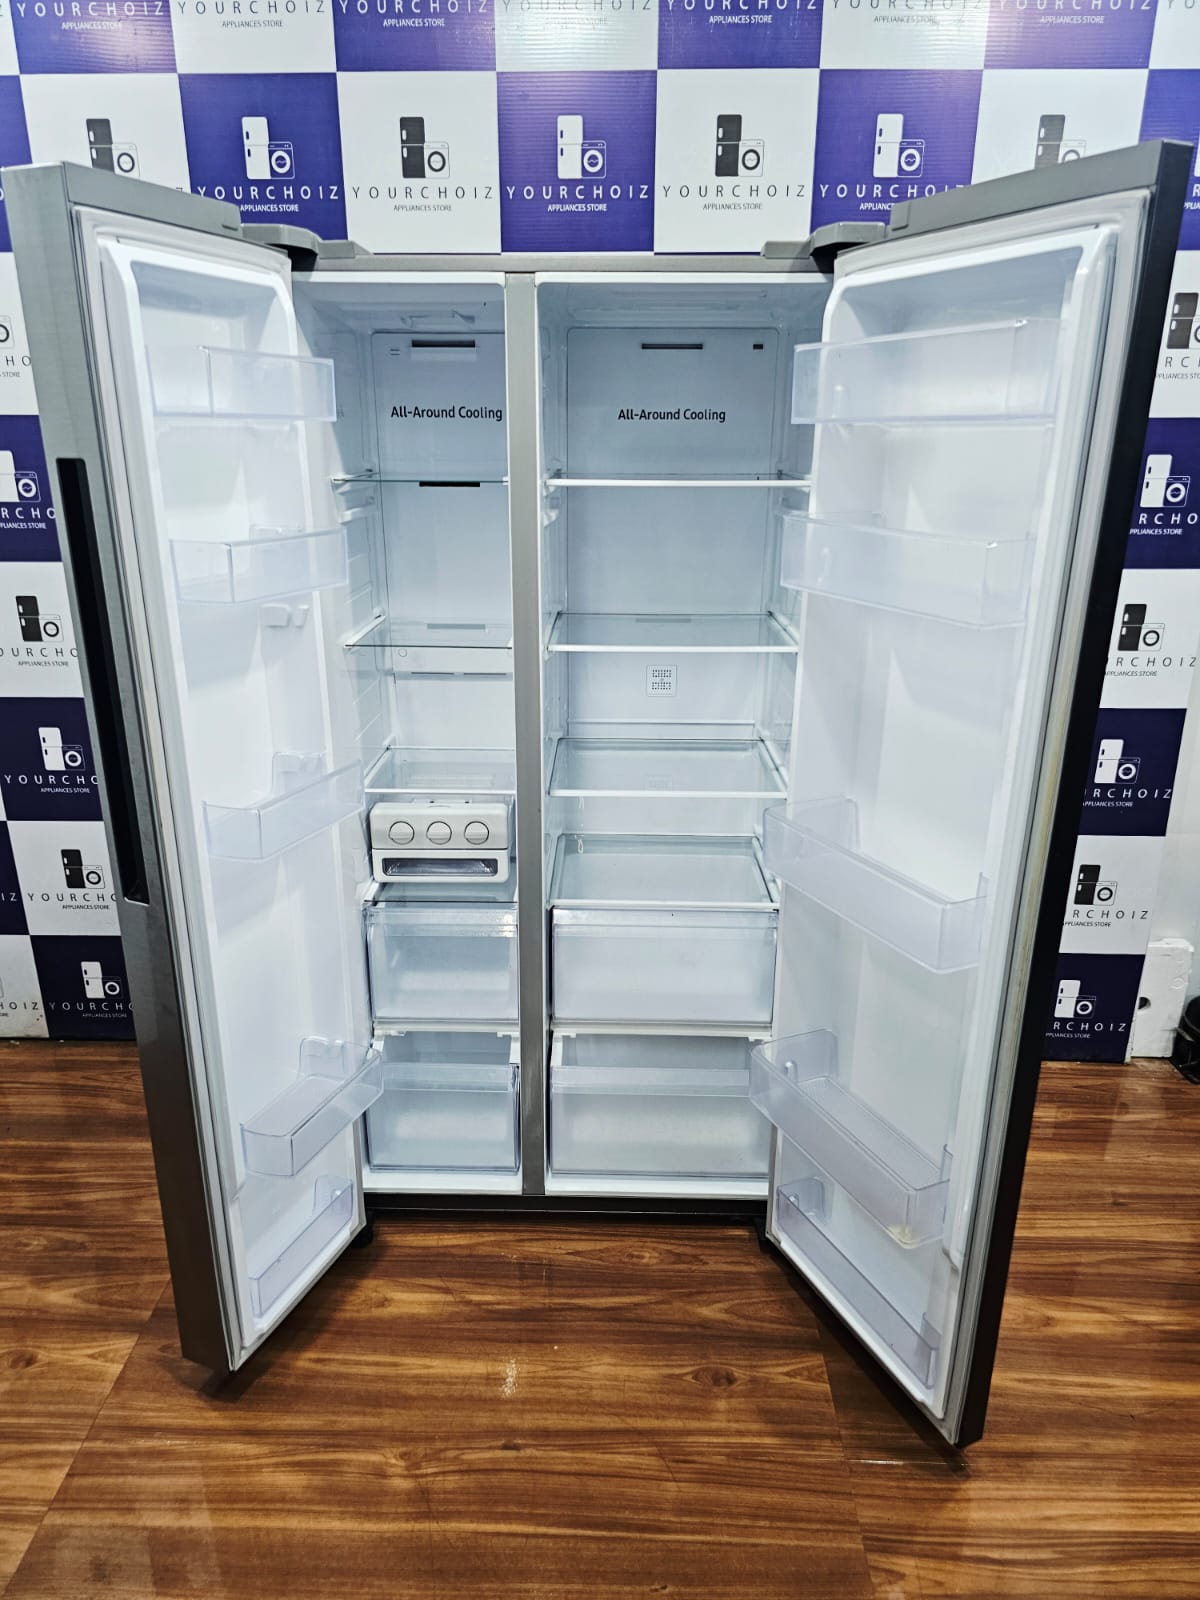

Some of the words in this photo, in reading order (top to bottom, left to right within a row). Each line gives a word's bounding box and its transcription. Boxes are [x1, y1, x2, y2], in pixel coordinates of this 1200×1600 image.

[16, 2, 164, 17] YOURCHOIZ
[178, 0, 325, 14] YOURCHOIZ
[338, 0, 487, 14] YOURCHOIZ
[667, 0, 817, 11] YOURCHOIZ
[222, 19, 262, 28] APPLIANCES
[262, 19, 283, 28] STORE
[383, 18, 422, 27] APPLIANCES
[423, 18, 445, 27] STORE
[708, 15, 750, 24] APPLIANCES
[750, 15, 773, 24] STORE
[1040, 15, 1082, 24] APPLIANCES
[1082, 15, 1105, 24] STORE
[197, 185, 339, 200] YOURCHOIZ
[352, 186, 493, 200] YOURCHOIZ
[506, 185, 649, 200] YOURCHOIZ
[662, 184, 805, 198] YOURCHOIZ
[819, 184, 965, 198] YOURCHOI
[240, 204, 278, 212] APPLIANCES
[278, 204, 299, 212] STORE
[394, 204, 432, 212] APPLIANCES
[432, 204, 452, 212] STORE
[547, 203, 586, 212] APPLIANCES
[586, 203, 608, 212] STORE
[702, 203, 742, 211] APPLIANCES
[742, 203, 763, 211] STORE
[390, 405, 455, 418] All-Around
[458, 405, 503, 422] Cooling
[617, 408, 681, 421] All-Around
[683, 408, 726, 424] Cooling
[1084, 788, 1172, 799] RCHOIZ
